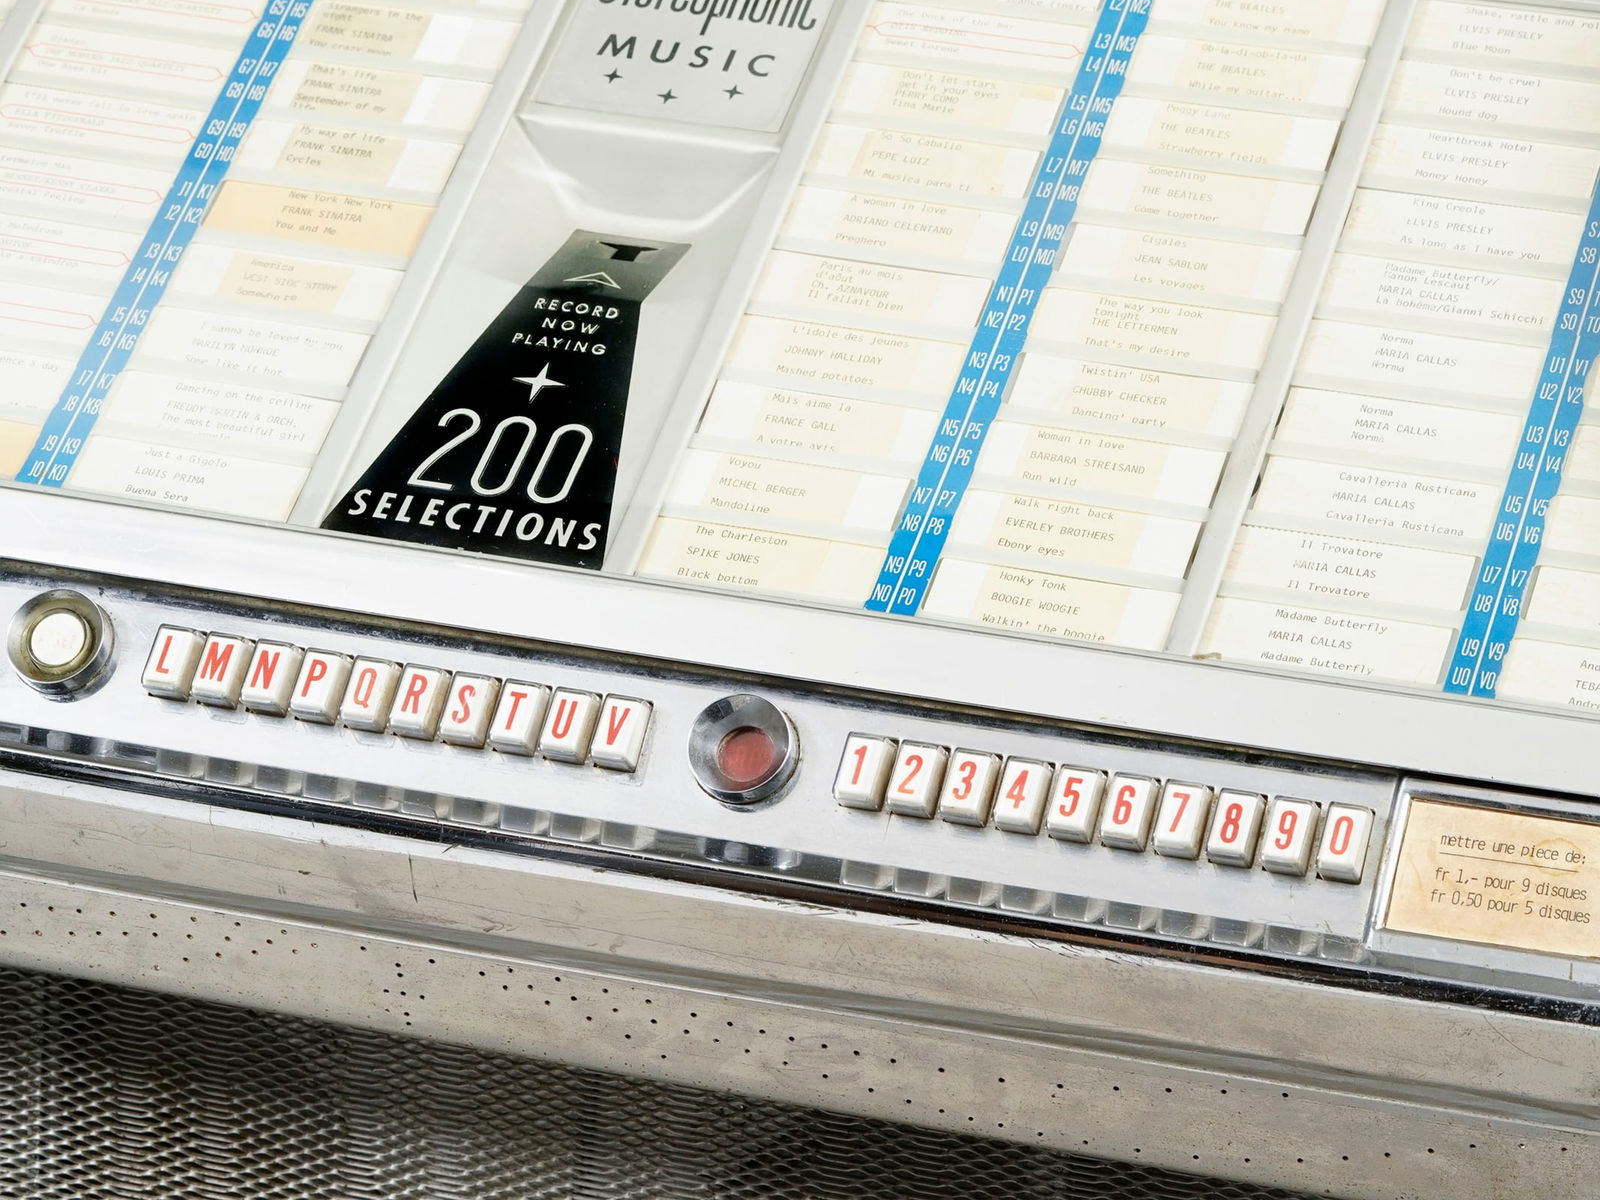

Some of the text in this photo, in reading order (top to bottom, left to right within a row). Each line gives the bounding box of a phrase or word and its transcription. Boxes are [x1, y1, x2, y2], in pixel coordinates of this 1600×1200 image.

[269, 0, 308, 18] G5 H5
[597, 33, 775, 77] MUSIC
[1070, 94, 1112, 114] L5 M5
[1444, 87, 1530, 106] ELVIS PRESLEY
[207, 119, 246, 139] G9 H9
[288, 190, 394, 211] New York New York
[1141, 185, 1214, 203] THE BEATLES
[281, 205, 363, 224] FRANK SINATRA
[274, 220, 337, 236] You and Me
[145, 242, 182, 262] J3 K3
[1011, 246, 1055, 266] L0 M0
[1580, 247, 1597, 264] S8
[1568, 288, 1586, 305] S9
[534, 297, 619, 319] RECORD
[542, 317, 600, 335] NOW
[511, 332, 607, 356] PLAYING
[784, 345, 824, 359] JOHNNY
[776, 364, 874, 386] Mashed potatoes
[1080, 364, 1161, 384] Twistin' USA
[1549, 356, 1589, 377] U1 V1
[772, 393, 852, 412] Mais aime la
[1072, 385, 1168, 406] CHUBBY CHECKER
[1359, 403, 1394, 417] Norma
[765, 414, 837, 432] FRANCE GALL
[941, 419, 983, 440] N5 P5
[1354, 418, 1438, 438] MARIA CALLAS
[1037, 430, 1125, 451] Woman in love
[407, 408, 593, 504] 200
[728, 456, 761, 470] Voyou
[1029, 450, 1146, 475] BARBARA STREISAND
[28, 460, 68, 481] J0 K0
[135, 465, 206, 486] LOUIS PRIMA
[1022, 470, 1078, 487] Run wild
[124, 484, 157, 498] Buena
[719, 477, 806, 498] MICHEL BERGER
[1338, 471, 1478, 499] Cavalleria Rusticana
[710, 497, 771, 514] Mandoline
[1014, 495, 1115, 521] Walk right back
[1332, 490, 1416, 510] MARIA CALLAS
[348, 489, 601, 551] SELECTIONS
[901, 512, 945, 535] N8 P8
[1005, 515, 1115, 542] EVERLEY BROTHERS
[1325, 509, 1465, 537] Cavalleria Rusticana
[695, 525, 788, 547] The Charleston
[1496, 523, 1540, 545] U6 V6
[687, 546, 760, 564] SPIKE JONES
[997, 537, 1065, 558] Ebony eyes
[1300, 538, 1384, 560] Il Trovatore
[677, 567, 758, 586] Black bottom
[999, 570, 1067, 591] Honky Tonk
[1334, 564, 1378, 579] CALLAS
[872, 582, 916, 606] N0 P0
[1287, 579, 1371, 600] Il Trovatore
[990, 591, 1081, 616] BOOGIE WOOGIE
[981, 612, 1030, 630] Walkin'
[1037, 620, 1057, 633] the
[1275, 608, 1389, 635] Madame Butterfly
[1268, 628, 1353, 651] MARIA CALLAS
[155, 635, 173, 674] L
[200, 642, 235, 682] M
[1260, 650, 1374, 677] Madame Butterfly
[250, 650, 280, 690] N
[300, 659, 328, 698] P
[1451, 667, 1496, 690] U0 V0
[353, 668, 378, 708] Q
[401, 673, 428, 715] R
[451, 684, 476, 724] S
[505, 691, 527, 731] T
[551, 699, 578, 739] U
[607, 705, 632, 747] V
[850, 745, 868, 785] 1
[897, 754, 924, 795] 2
[952, 761, 977, 800] 3
[1005, 770, 1029, 810] 4
[1059, 777, 1084, 817] 5
[1112, 784, 1136, 825] 6
[1168, 792, 1191, 833] 7
[1220, 803, 1243, 844] 8
[1274, 810, 1298, 850] 9
[1329, 816, 1354, 856] 0
[1440, 834, 1586, 865] mettre une piece de:
[1435, 866, 1587, 902] fr 1,- pour 9 disques
[1431, 889, 1591, 924] fr 0,50 pour 5 disques
